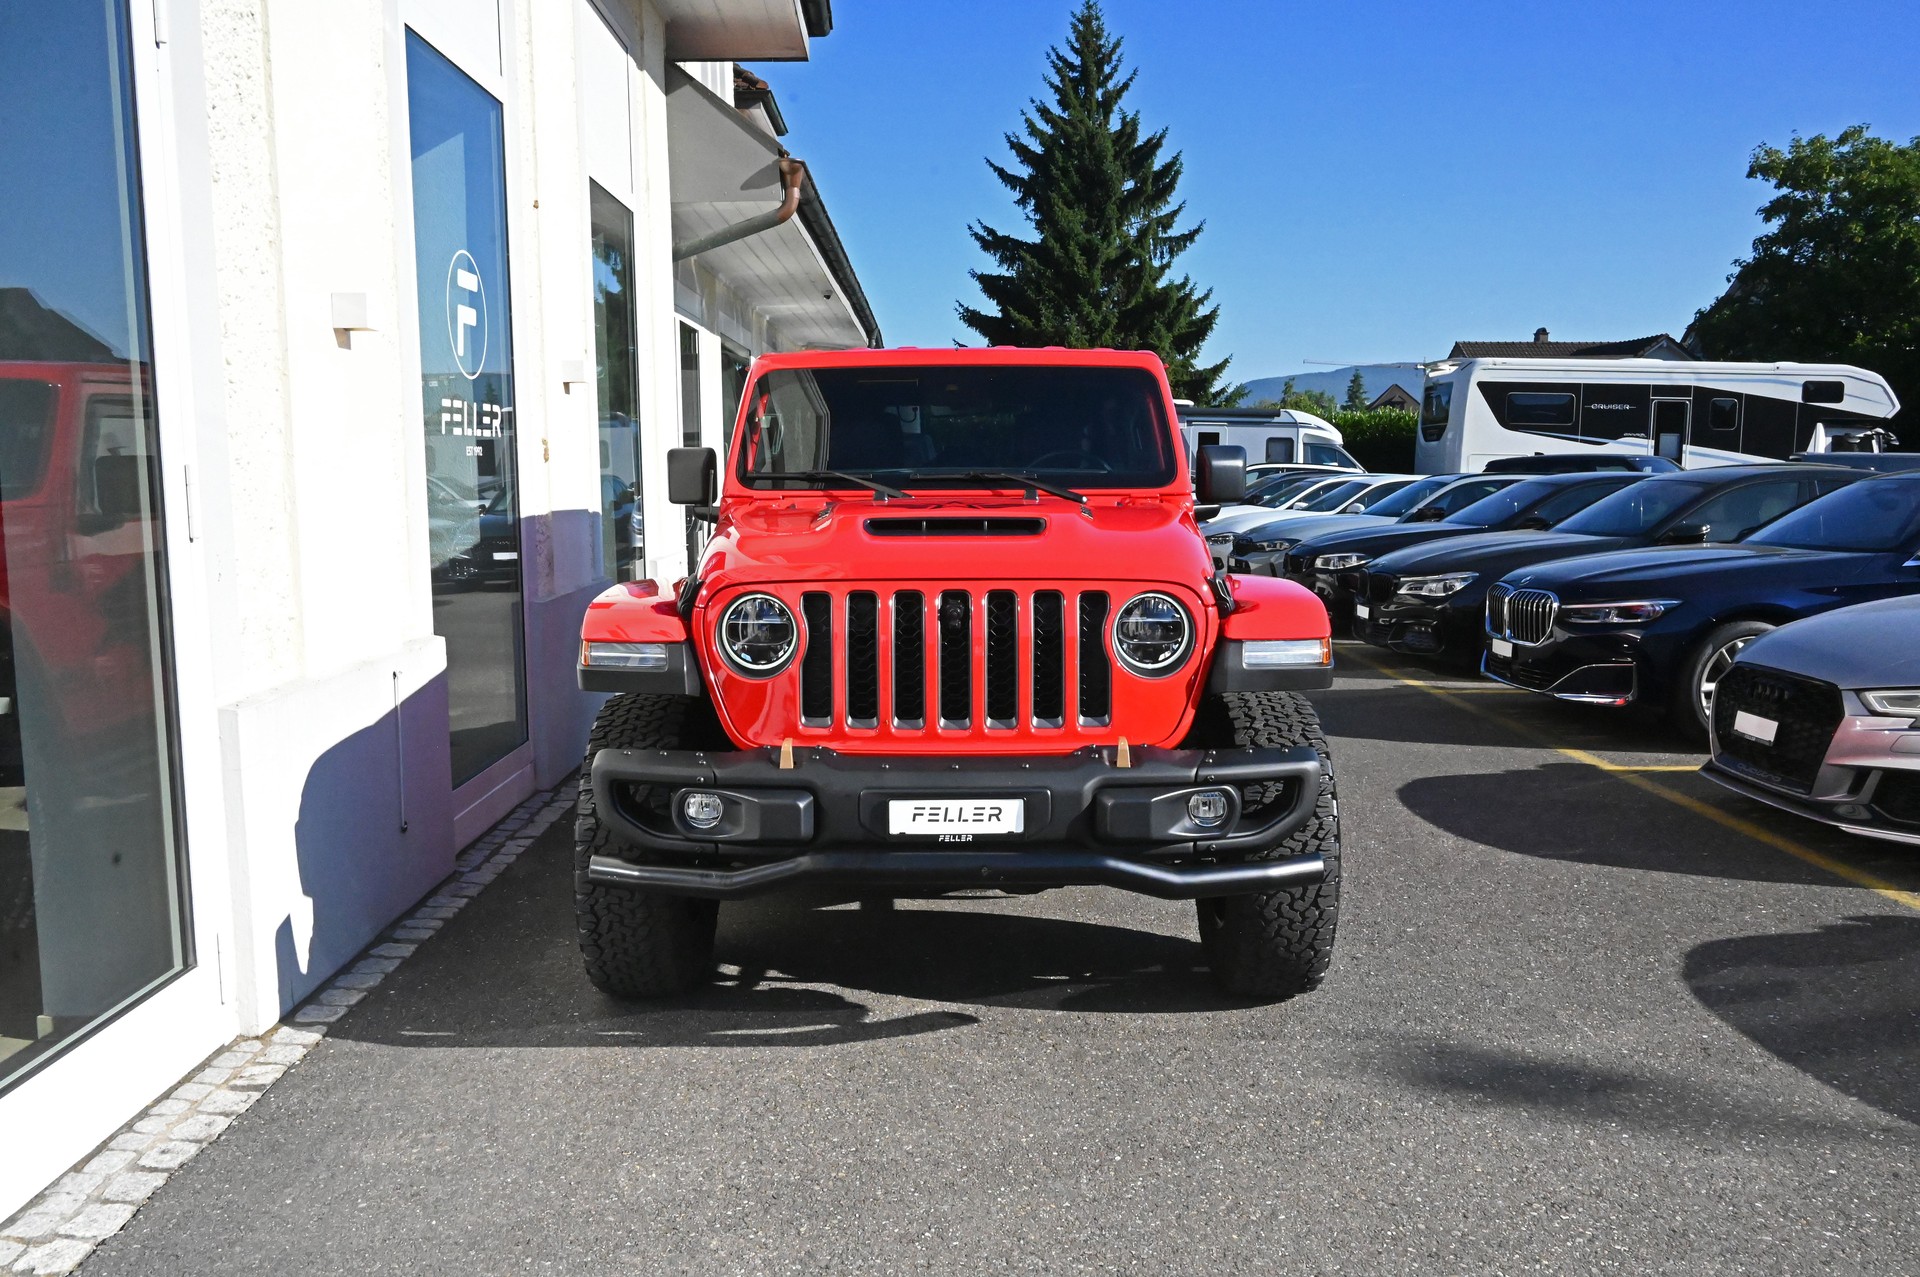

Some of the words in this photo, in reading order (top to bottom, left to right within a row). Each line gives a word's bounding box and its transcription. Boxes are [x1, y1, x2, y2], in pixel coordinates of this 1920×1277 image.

[457, 268, 478, 357] F
[441, 398, 502, 438] FELLER
[912, 806, 1003, 822] FELLER
[938, 834, 973, 842] FELLER
